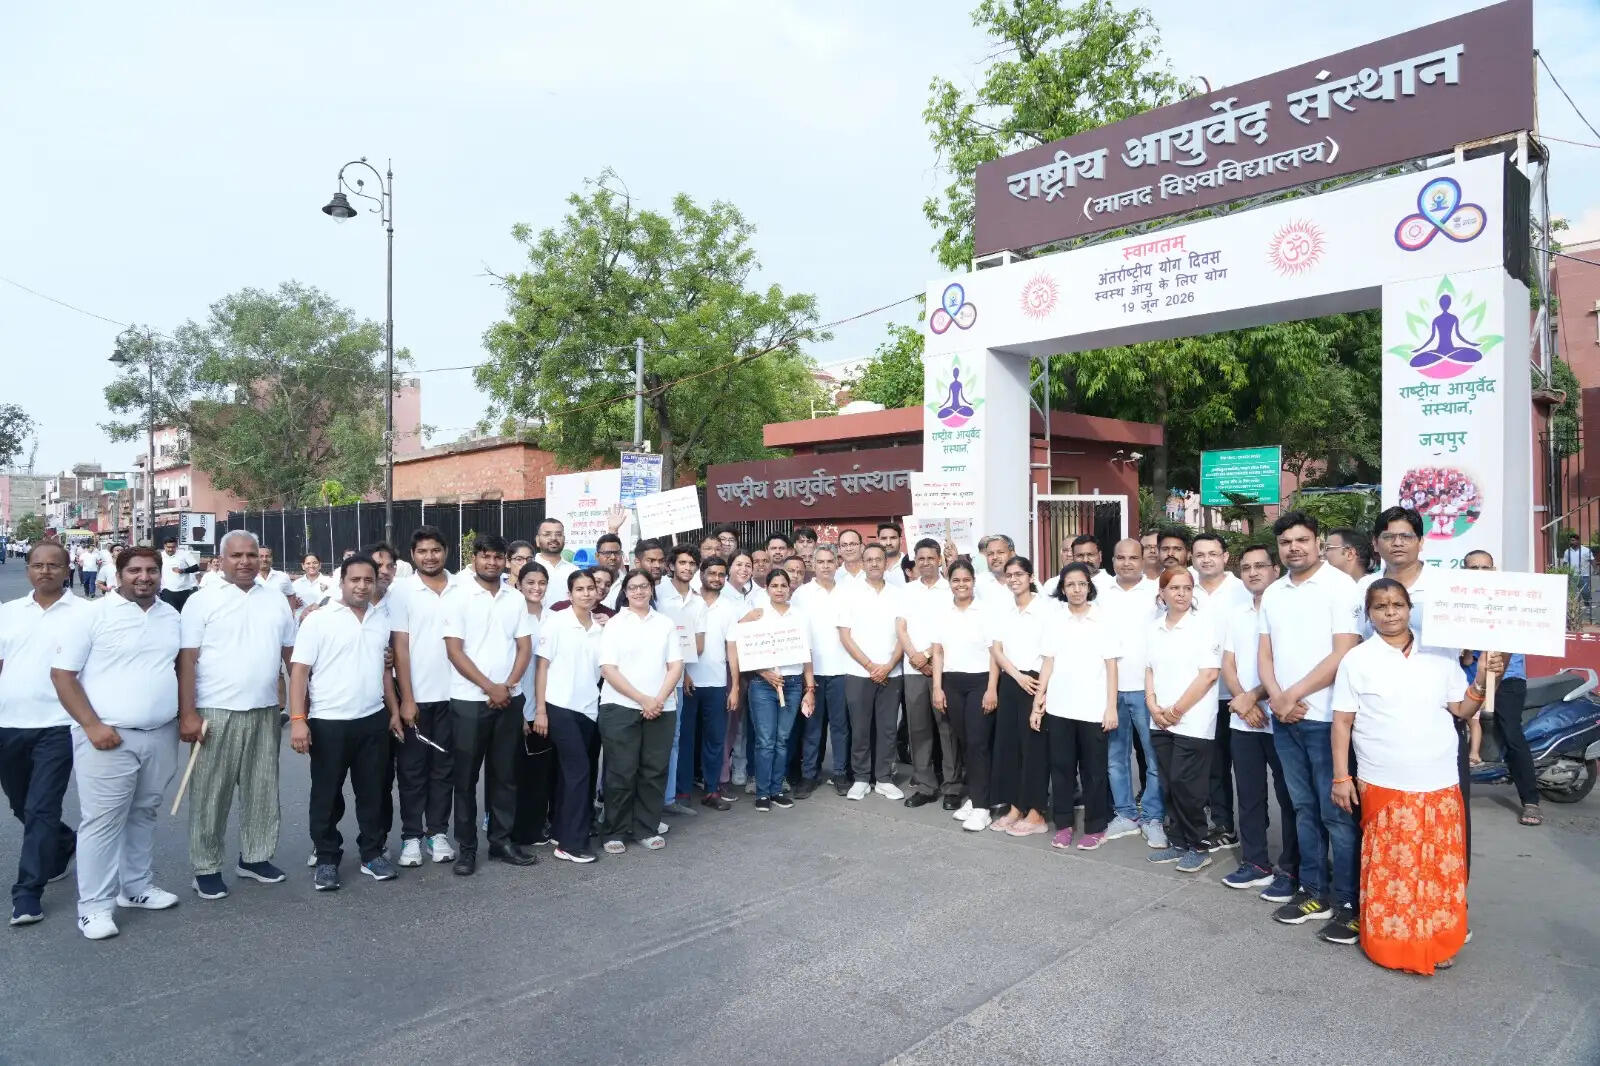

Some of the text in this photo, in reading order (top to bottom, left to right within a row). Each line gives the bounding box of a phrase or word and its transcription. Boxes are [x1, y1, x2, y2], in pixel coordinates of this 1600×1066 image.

[1007, 43, 1465, 201] राष्ट्रीय आयुर्वेद संस्थान
[1083, 136, 1340, 221] (मानद विश्वविद्यालय)
[1122, 235, 1187, 260] स्वागतम्
[1098, 250, 1221, 285] अंतर्राष्ट्रीय योग दिवस
[1095, 268, 1228, 301] स्वस्थ आयु के लिए योग
[1122, 292, 1195, 313] 19 जून 2026
[1399, 376, 1496, 401] राष्ट्रीय आयुर्वेद
[1422, 399, 1472, 416] संस्थान,
[1418, 431, 1468, 452] जयपुर
[716, 464, 914, 507] राष्ट्रीय आयुर्वेद संस्थान
